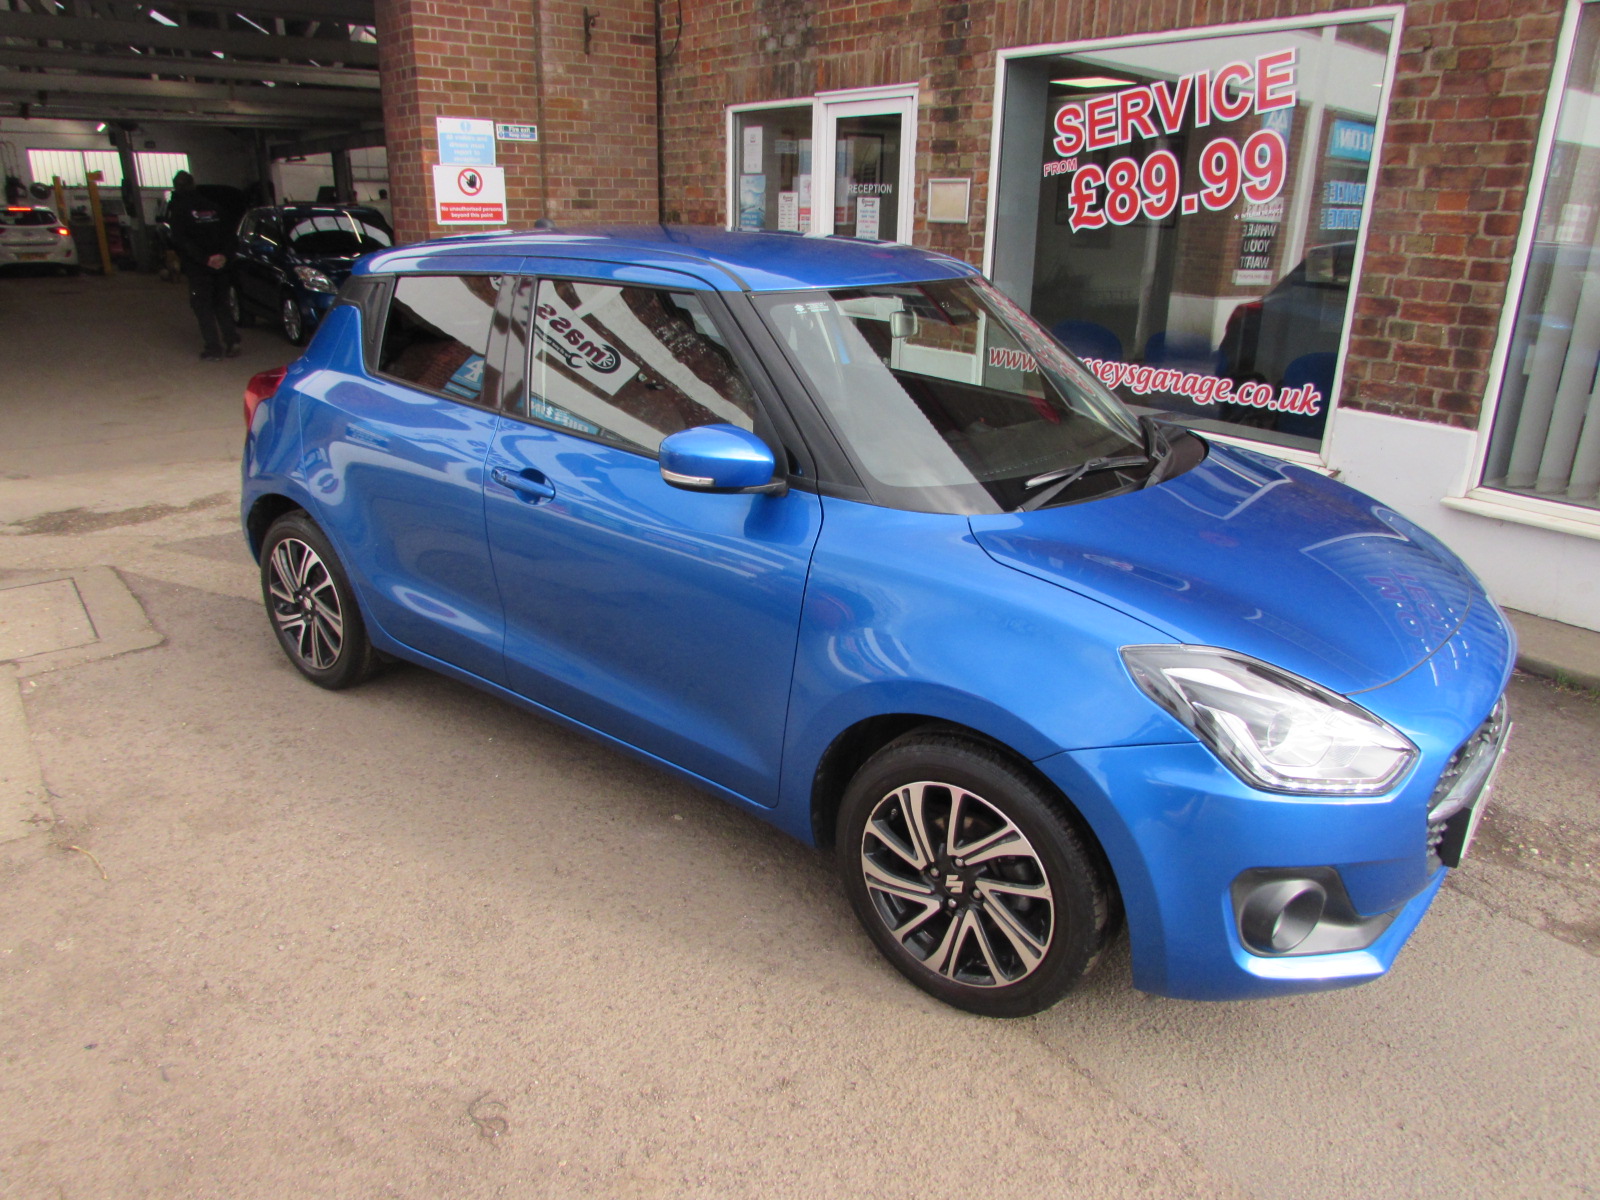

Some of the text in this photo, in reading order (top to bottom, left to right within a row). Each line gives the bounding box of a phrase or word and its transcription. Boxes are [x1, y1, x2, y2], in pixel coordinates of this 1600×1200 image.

[1053, 47, 1296, 157] SERVICE
[847, 183, 893, 194] RECEPTION
[1043, 157, 1078, 177] FROM
[1067, 129, 1287, 234] £89.99
